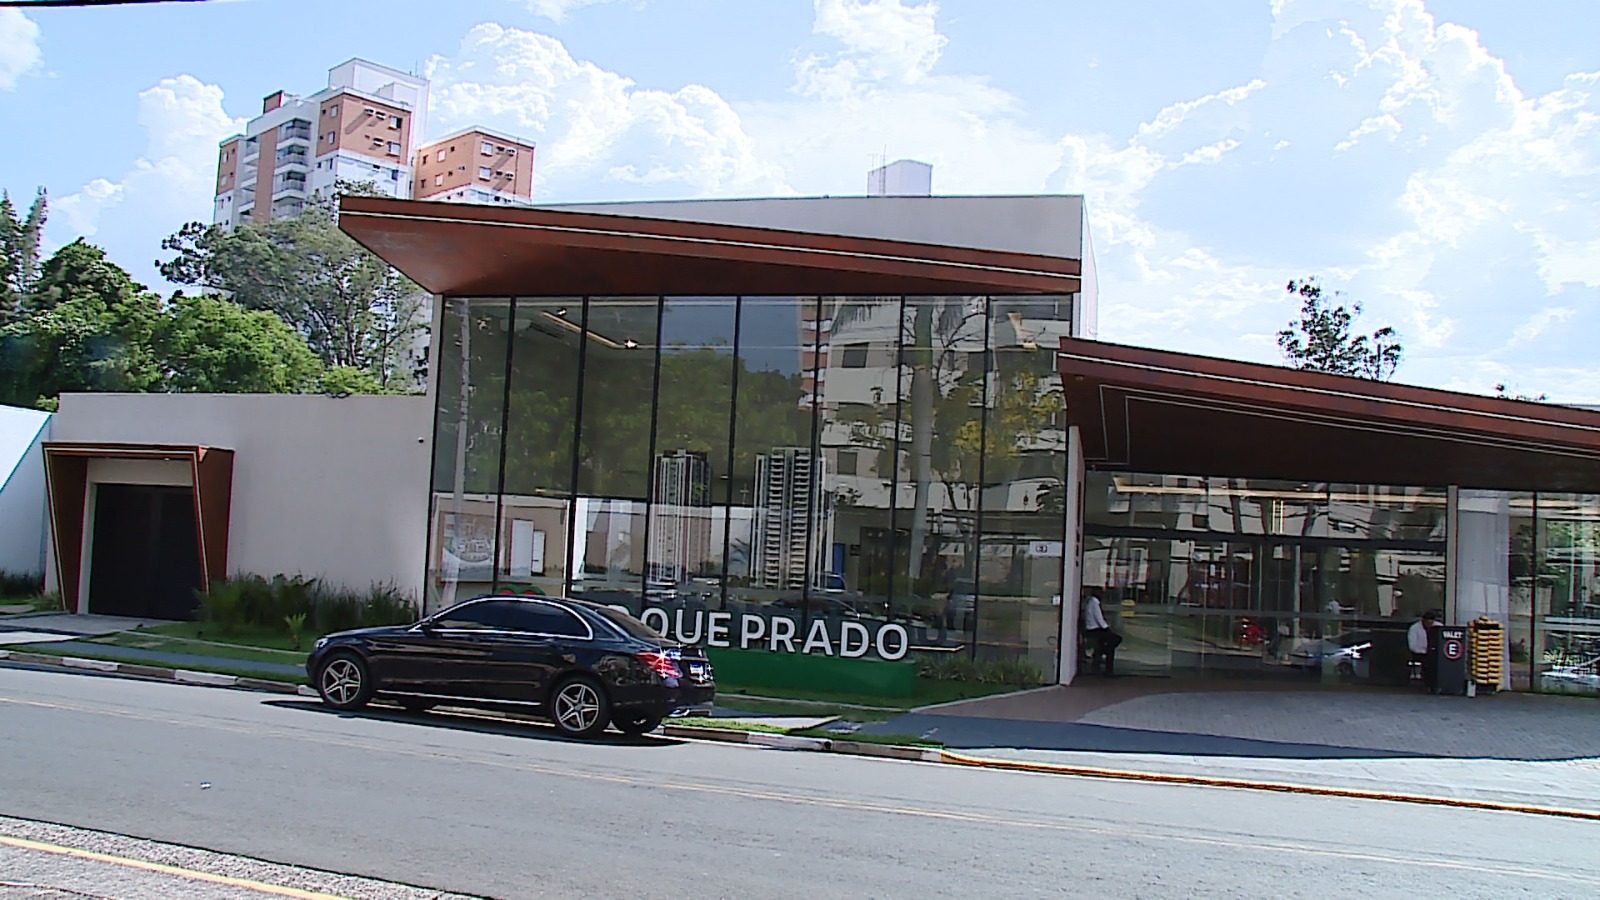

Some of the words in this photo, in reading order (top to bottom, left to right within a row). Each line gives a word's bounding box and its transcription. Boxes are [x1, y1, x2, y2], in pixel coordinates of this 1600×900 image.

[607, 604, 732, 648] QUE
[740, 614, 909, 661] PRADO
[1442, 630, 1463, 639] VALET
[1448, 643, 1458, 655] E
